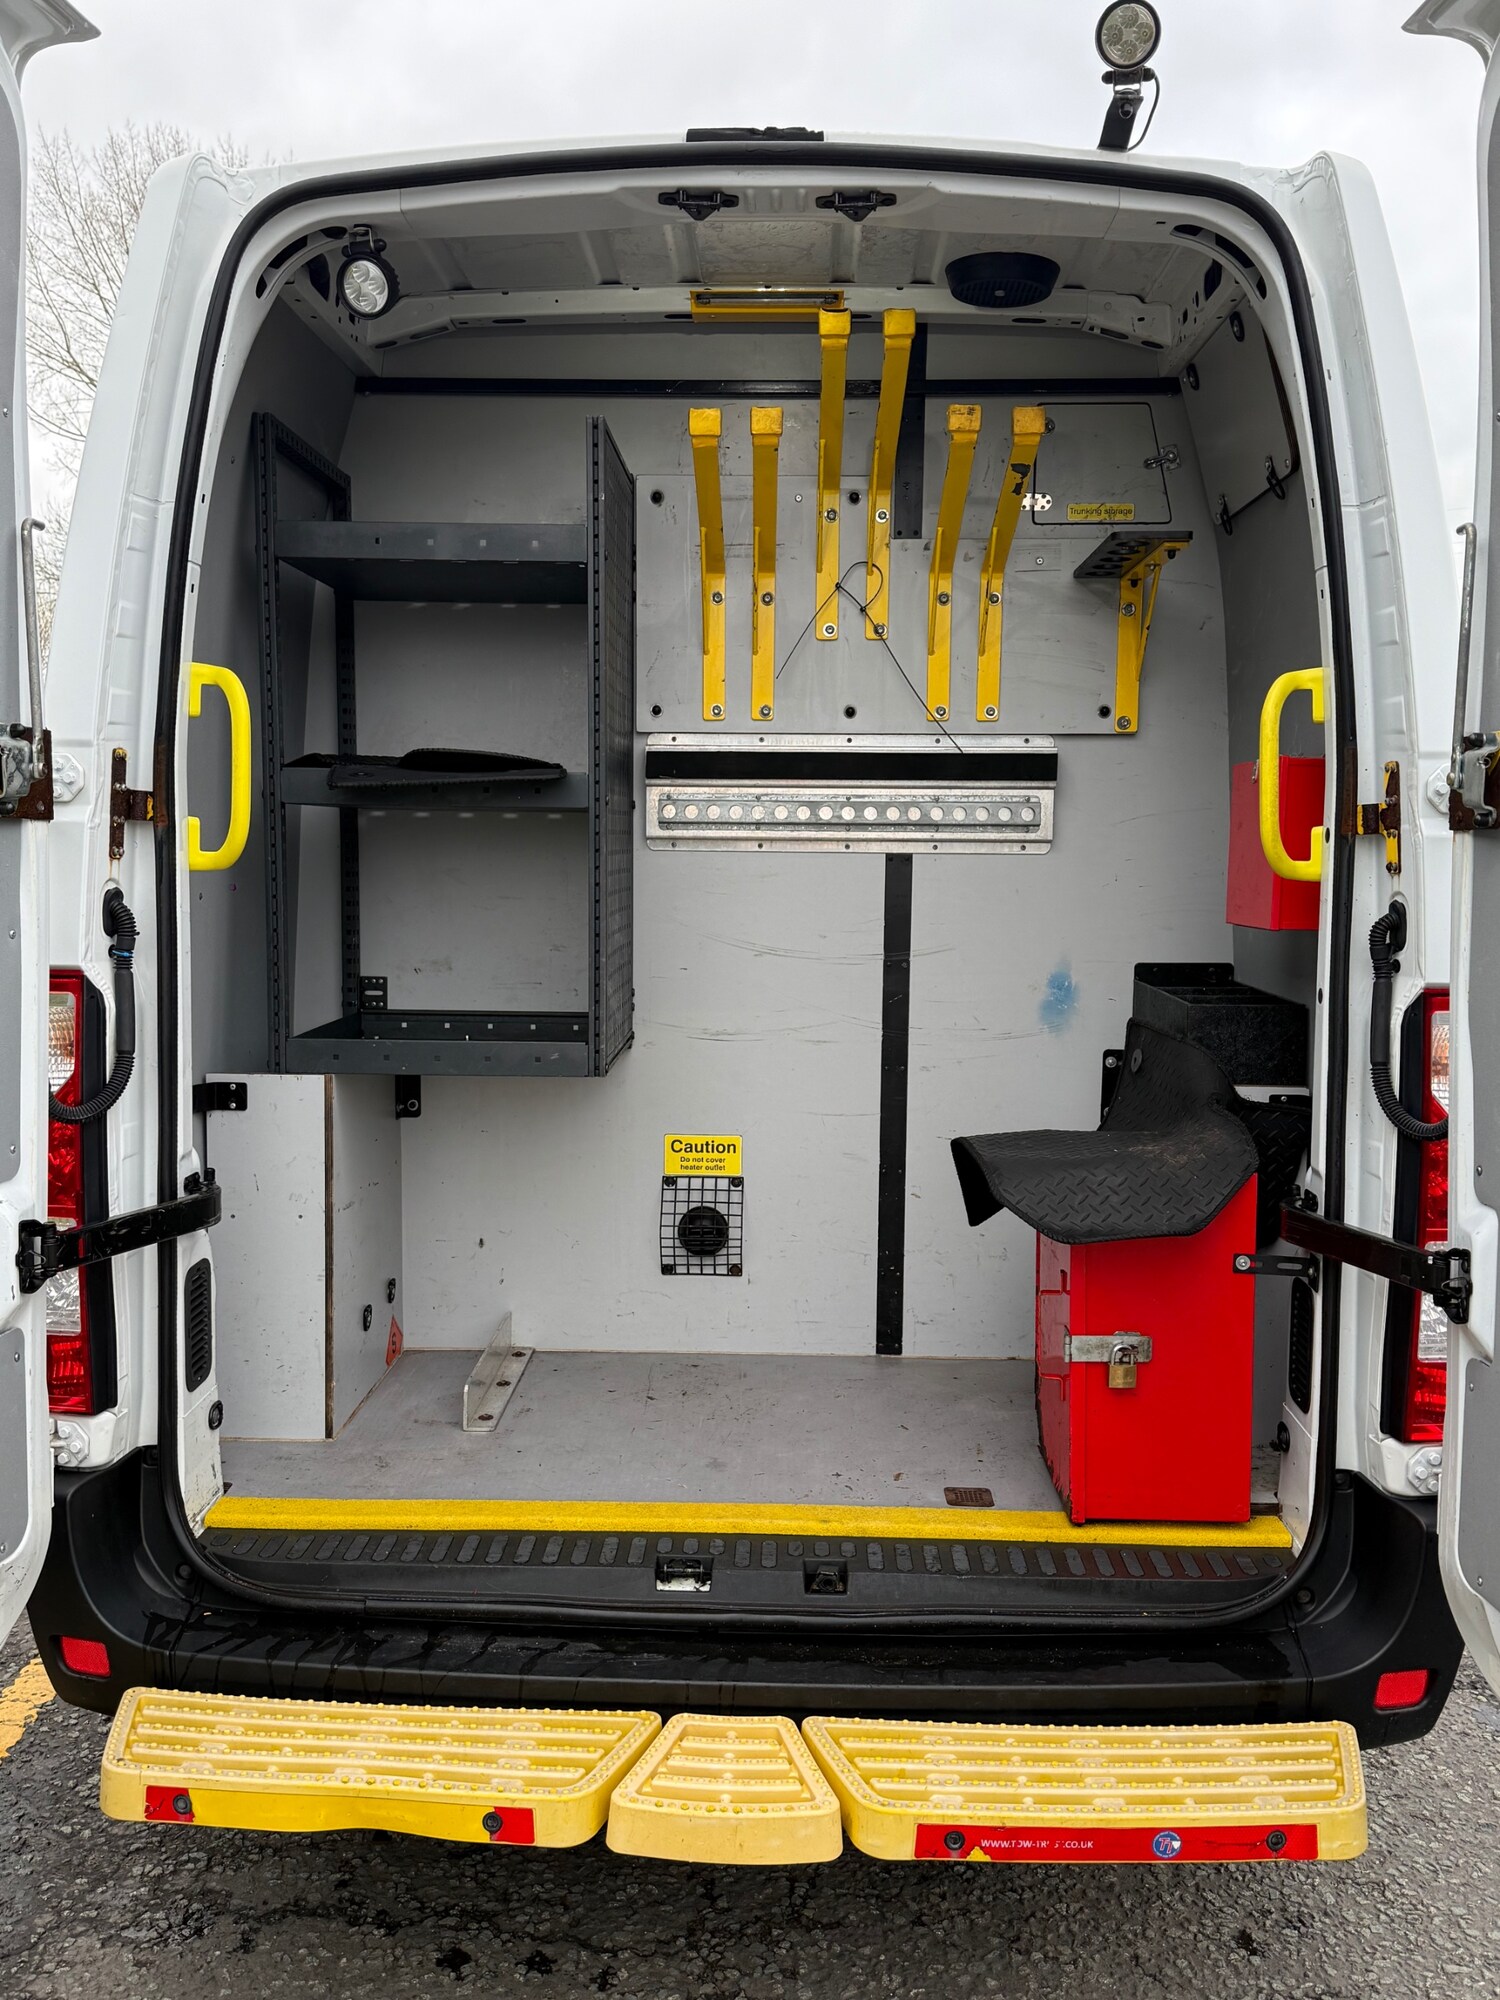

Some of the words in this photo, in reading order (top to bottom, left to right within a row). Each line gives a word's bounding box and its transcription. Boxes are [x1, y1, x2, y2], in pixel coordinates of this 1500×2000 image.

[1070, 507, 1102, 516] Trunking
[1103, 507, 1133, 516] storage
[671, 1139, 736, 1154] Caution
